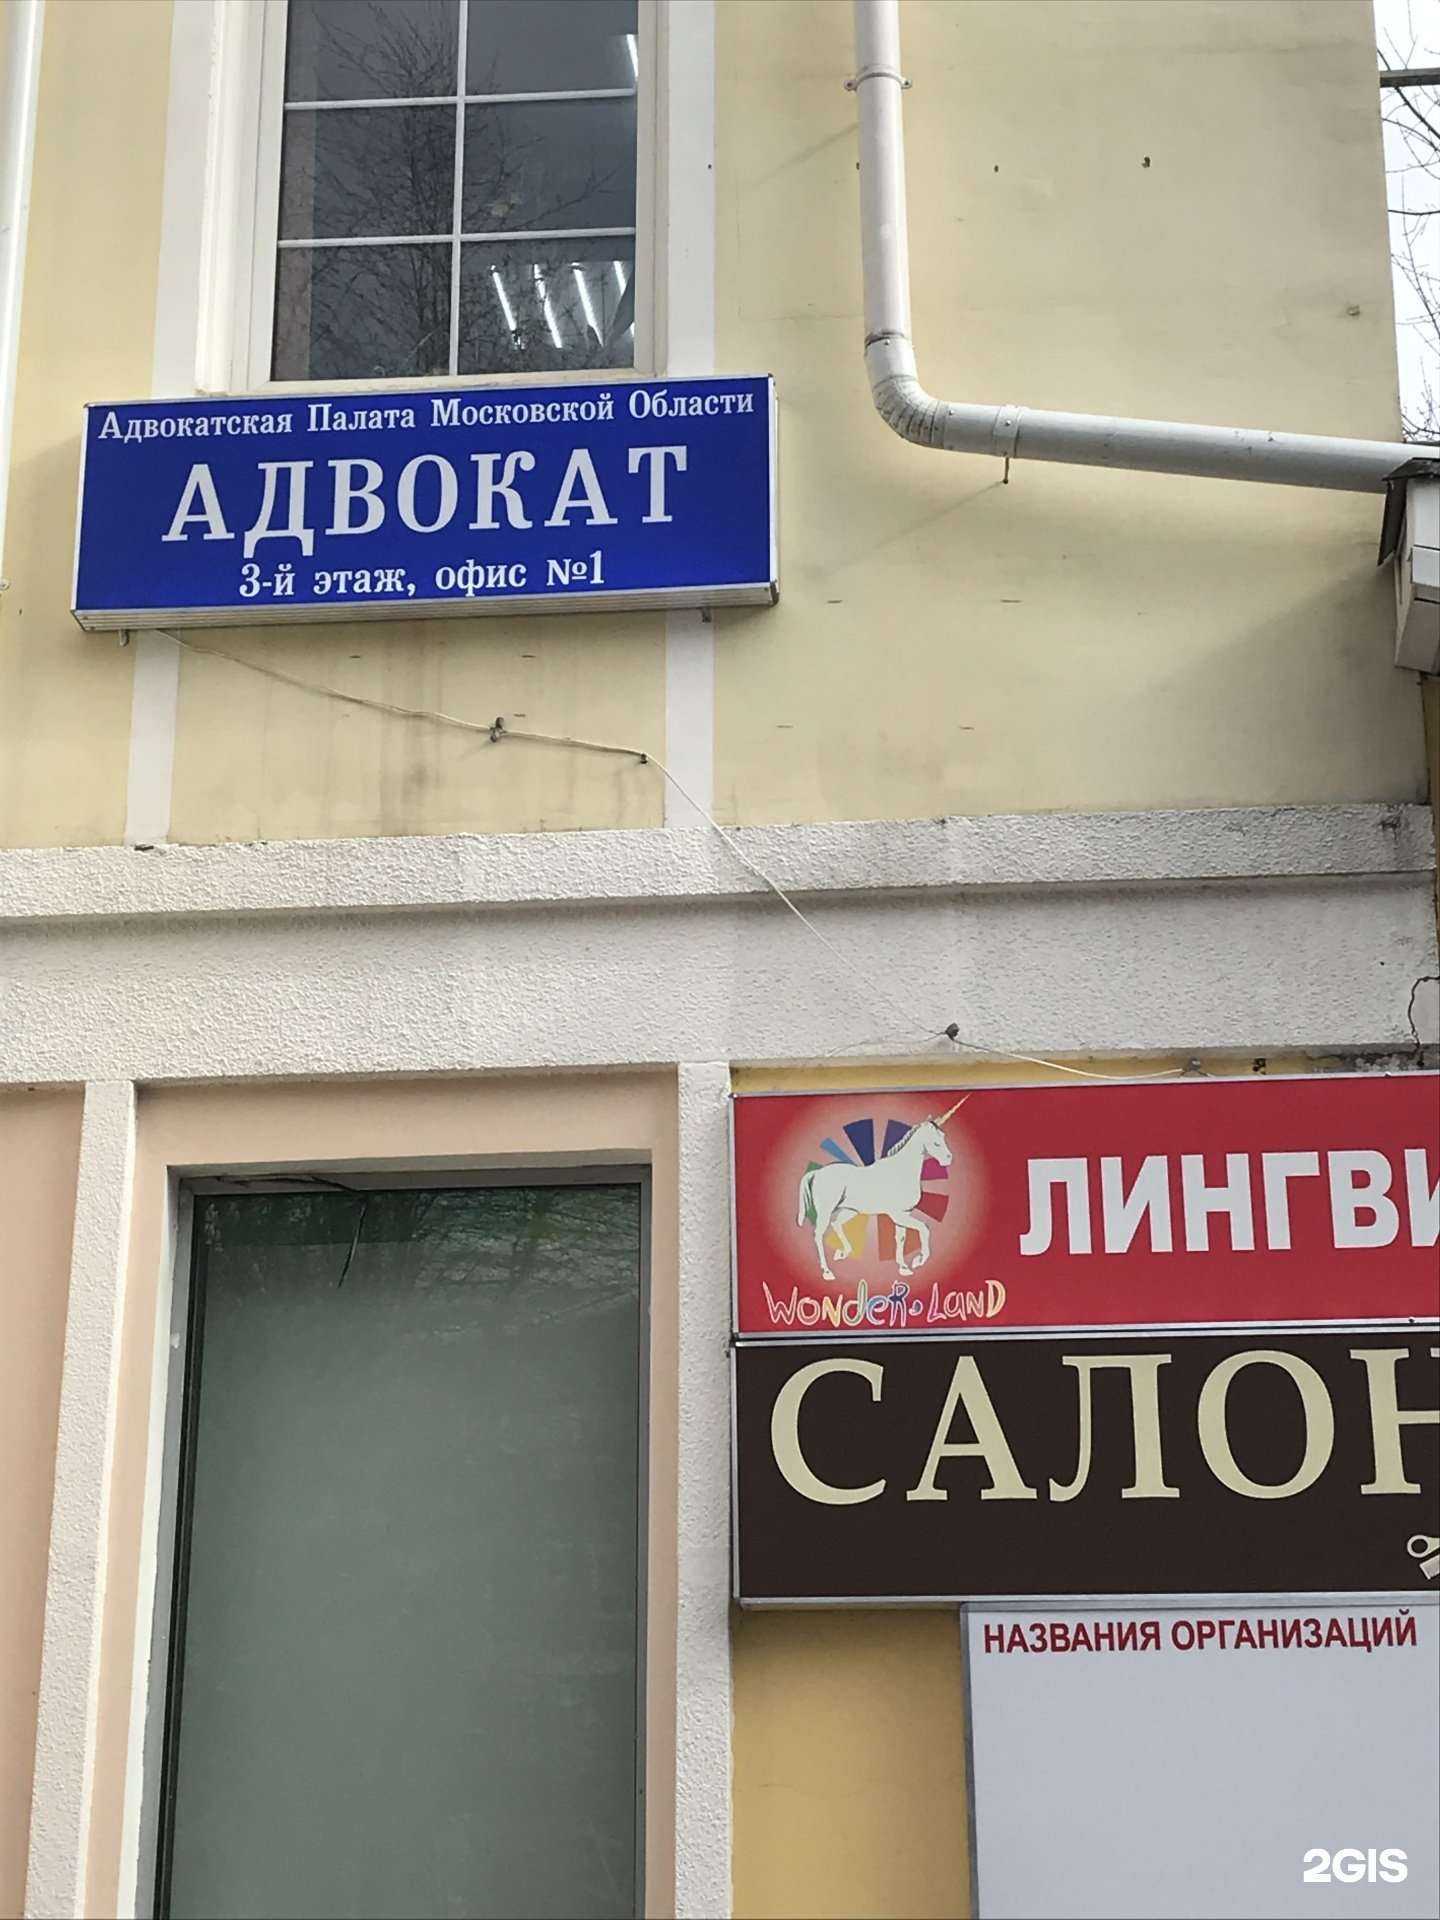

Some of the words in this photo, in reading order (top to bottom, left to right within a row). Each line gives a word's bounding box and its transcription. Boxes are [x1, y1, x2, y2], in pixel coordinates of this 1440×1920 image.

[98, 411, 293, 443] Адвокатская
[307, 402, 416, 433] Палата
[430, 391, 614, 427] Московской
[628, 389, 754, 419] Области
[161, 445, 688, 558] АДВОКАТ
[239, 562, 295, 598] 3-й
[314, 566, 416, 598] этаж,
[435, 558, 527, 598] офис
[546, 550, 605, 586] №1
[770, 1348, 1440, 1506] САЛОН
[983, 1620, 1161, 1654] НАЗВАНИЯ
[1171, 1608, 1418, 1653] ОРГАНИЗАЦИЙ
